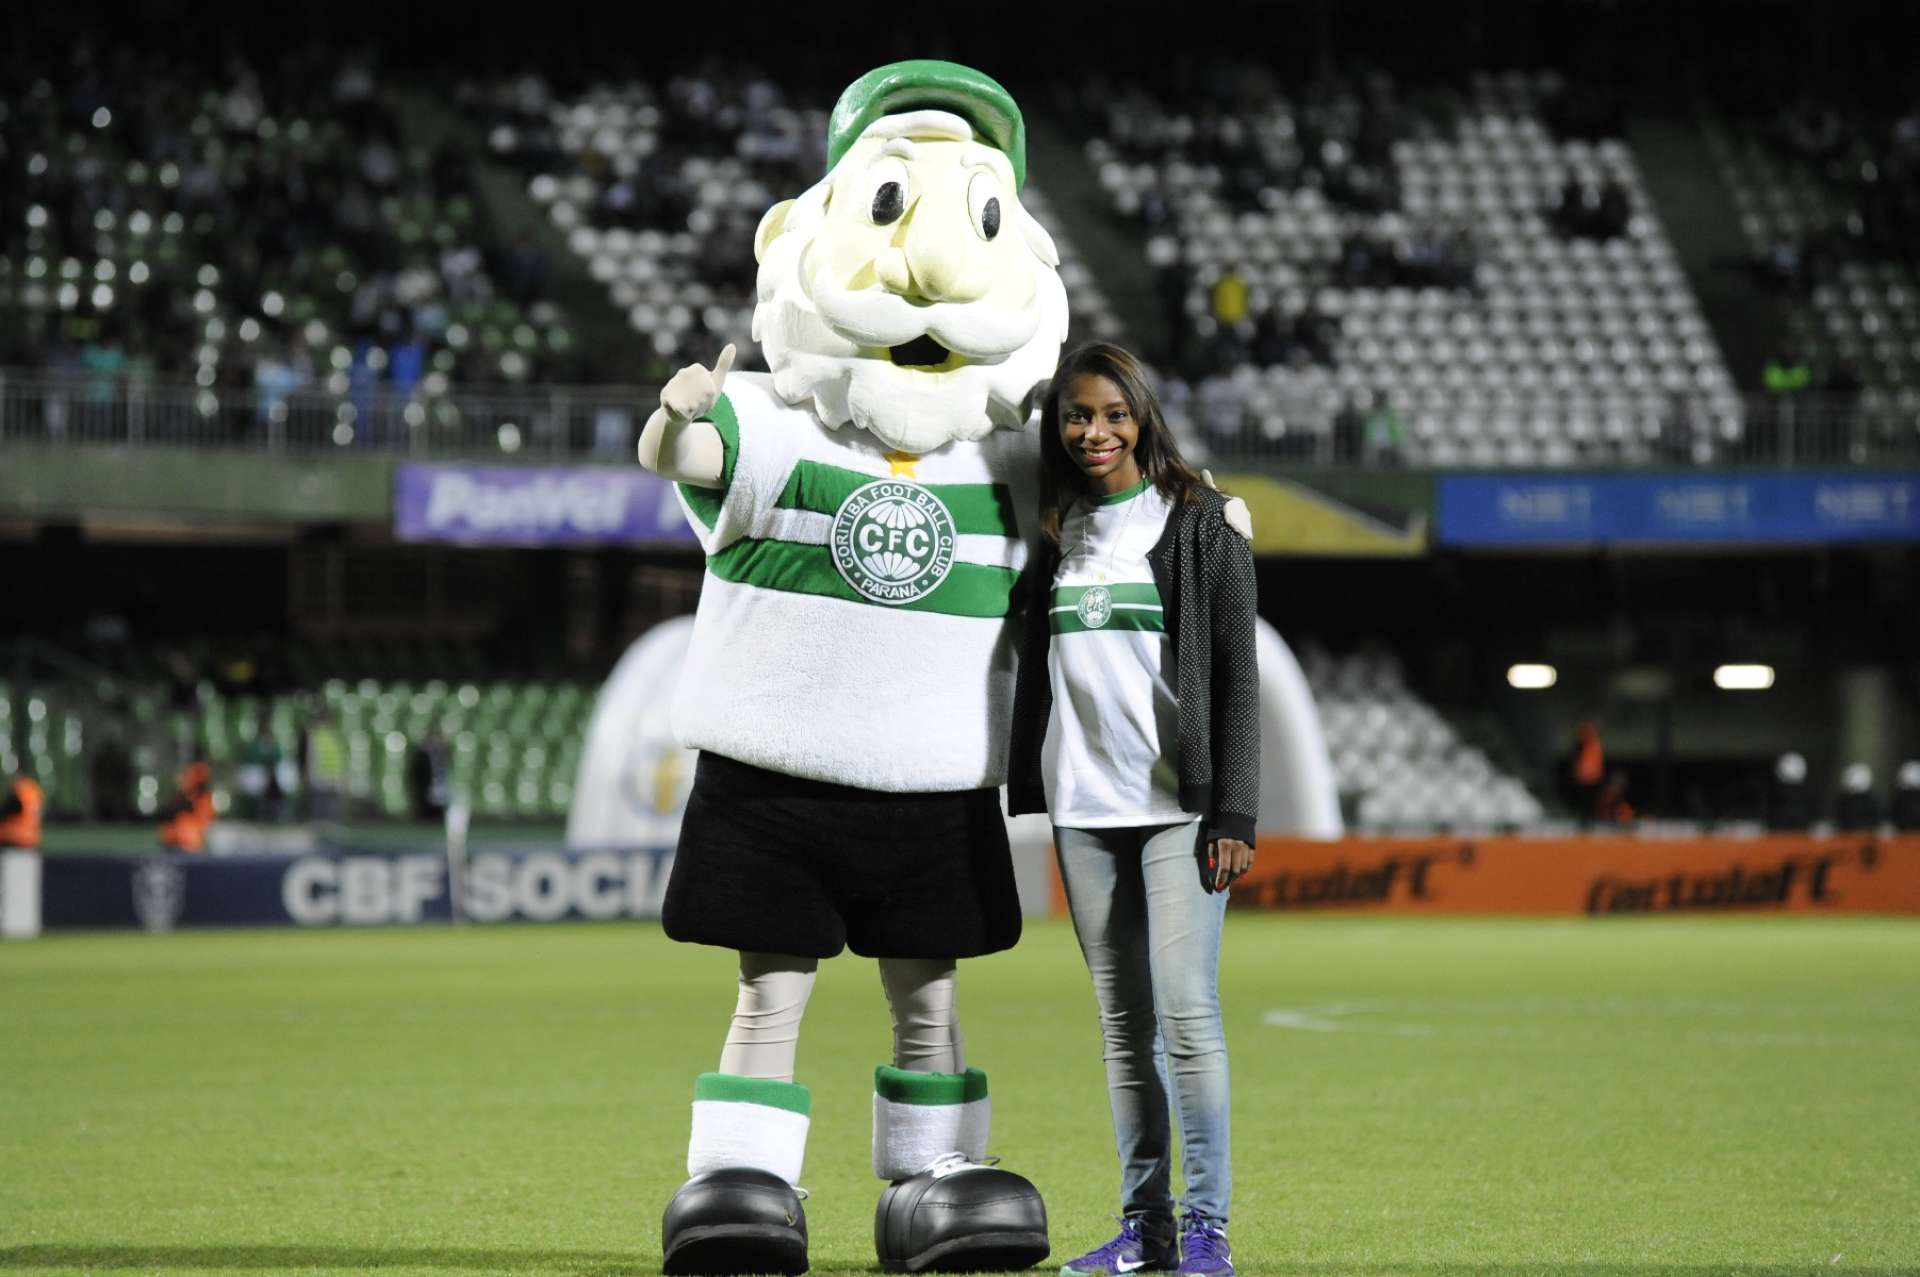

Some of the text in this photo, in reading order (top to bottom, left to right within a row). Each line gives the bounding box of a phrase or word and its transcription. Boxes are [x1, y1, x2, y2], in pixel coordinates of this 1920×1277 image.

[836, 485, 953, 577] CORITIBA FOOT BALL CLUB
[858, 523, 929, 558] CFC
[282, 856, 442, 922] CBF
